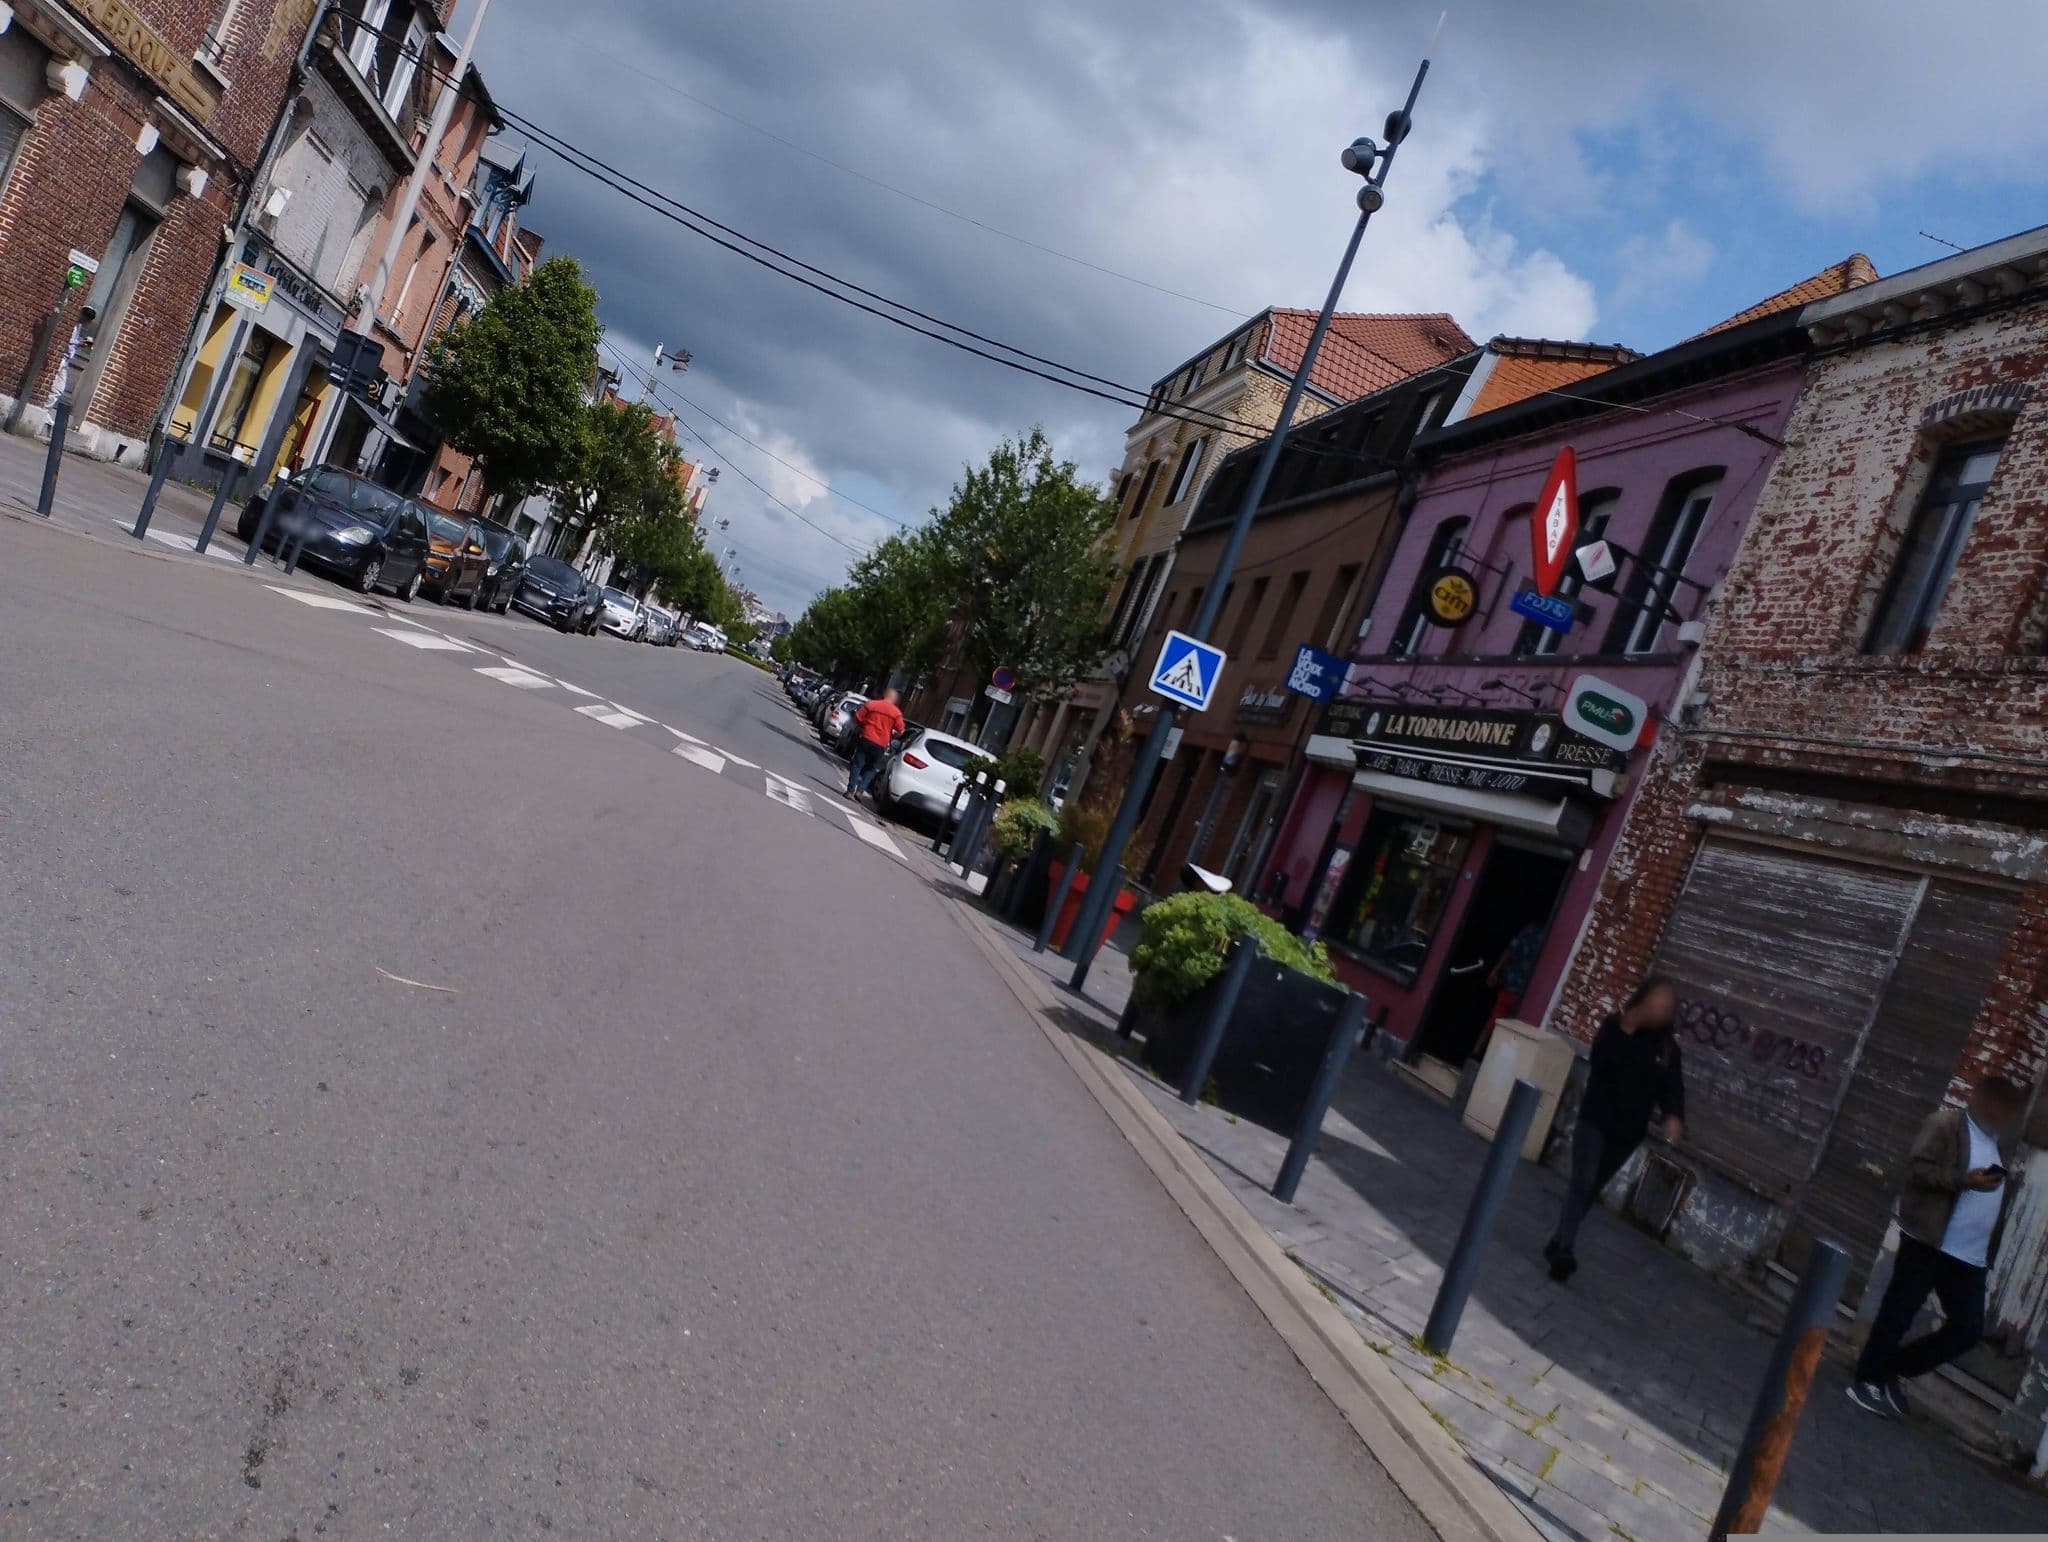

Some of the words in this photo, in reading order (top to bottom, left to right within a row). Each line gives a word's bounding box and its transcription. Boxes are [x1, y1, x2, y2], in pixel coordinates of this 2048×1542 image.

[102, 3, 176, 86] EPOQUE
[1549, 497, 1563, 549] TABAC
[1299, 648, 1312, 661] LA
[1291, 667, 1310, 682] DU
[1297, 656, 1324, 677] VOIX
[1287, 678, 1321, 697] NORD
[1581, 700, 1609, 720] PMU
[1385, 714, 1404, 735] LA
[1405, 715, 1517, 746] TORNABONNE
[1556, 743, 1613, 765] PRESSE
[1490, 774, 1526, 791] LOTO
